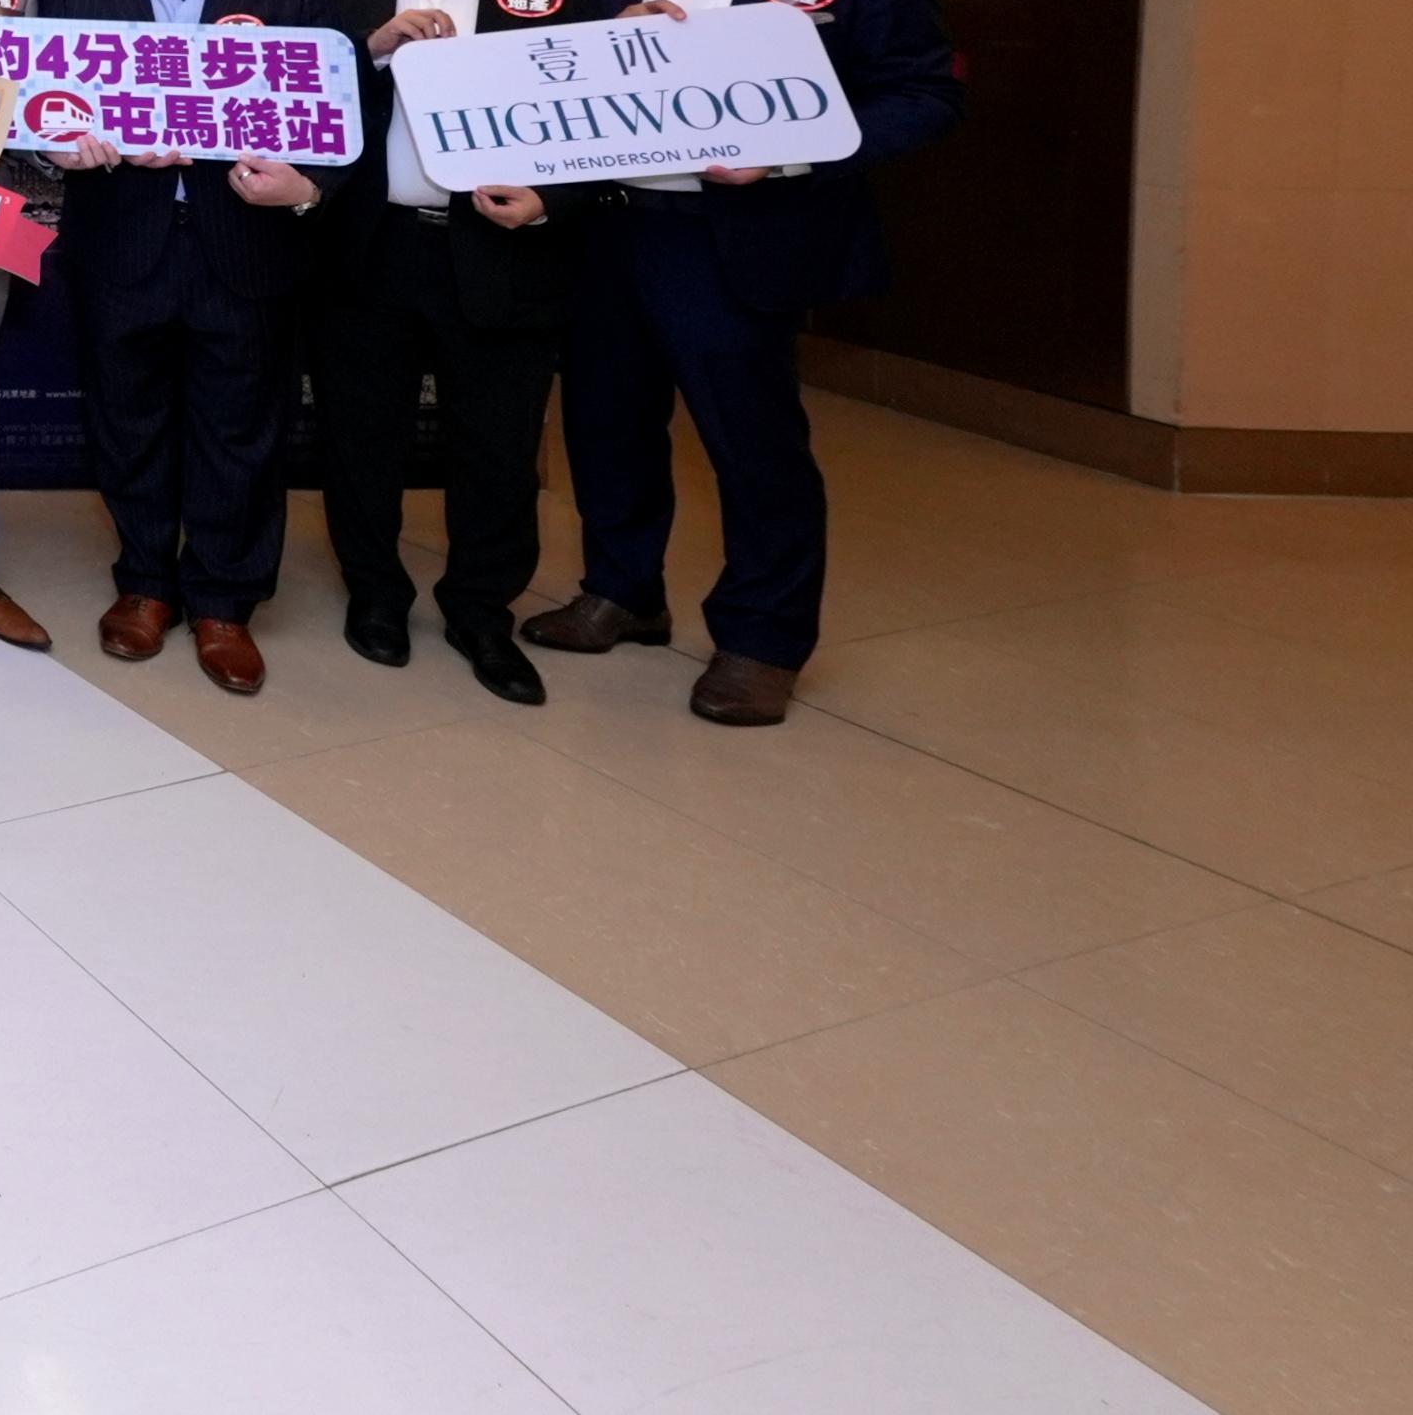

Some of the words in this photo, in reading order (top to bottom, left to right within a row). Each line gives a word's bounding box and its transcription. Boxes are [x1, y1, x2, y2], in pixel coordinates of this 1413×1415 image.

[99, 91, 348, 155] 屯馬綫站
[424, 76, 829, 153] HIGHWOOD
[534, 160, 556, 176] by
[562, 150, 682, 171] HENDERSON
[686, 144, 742, 161] LAND
